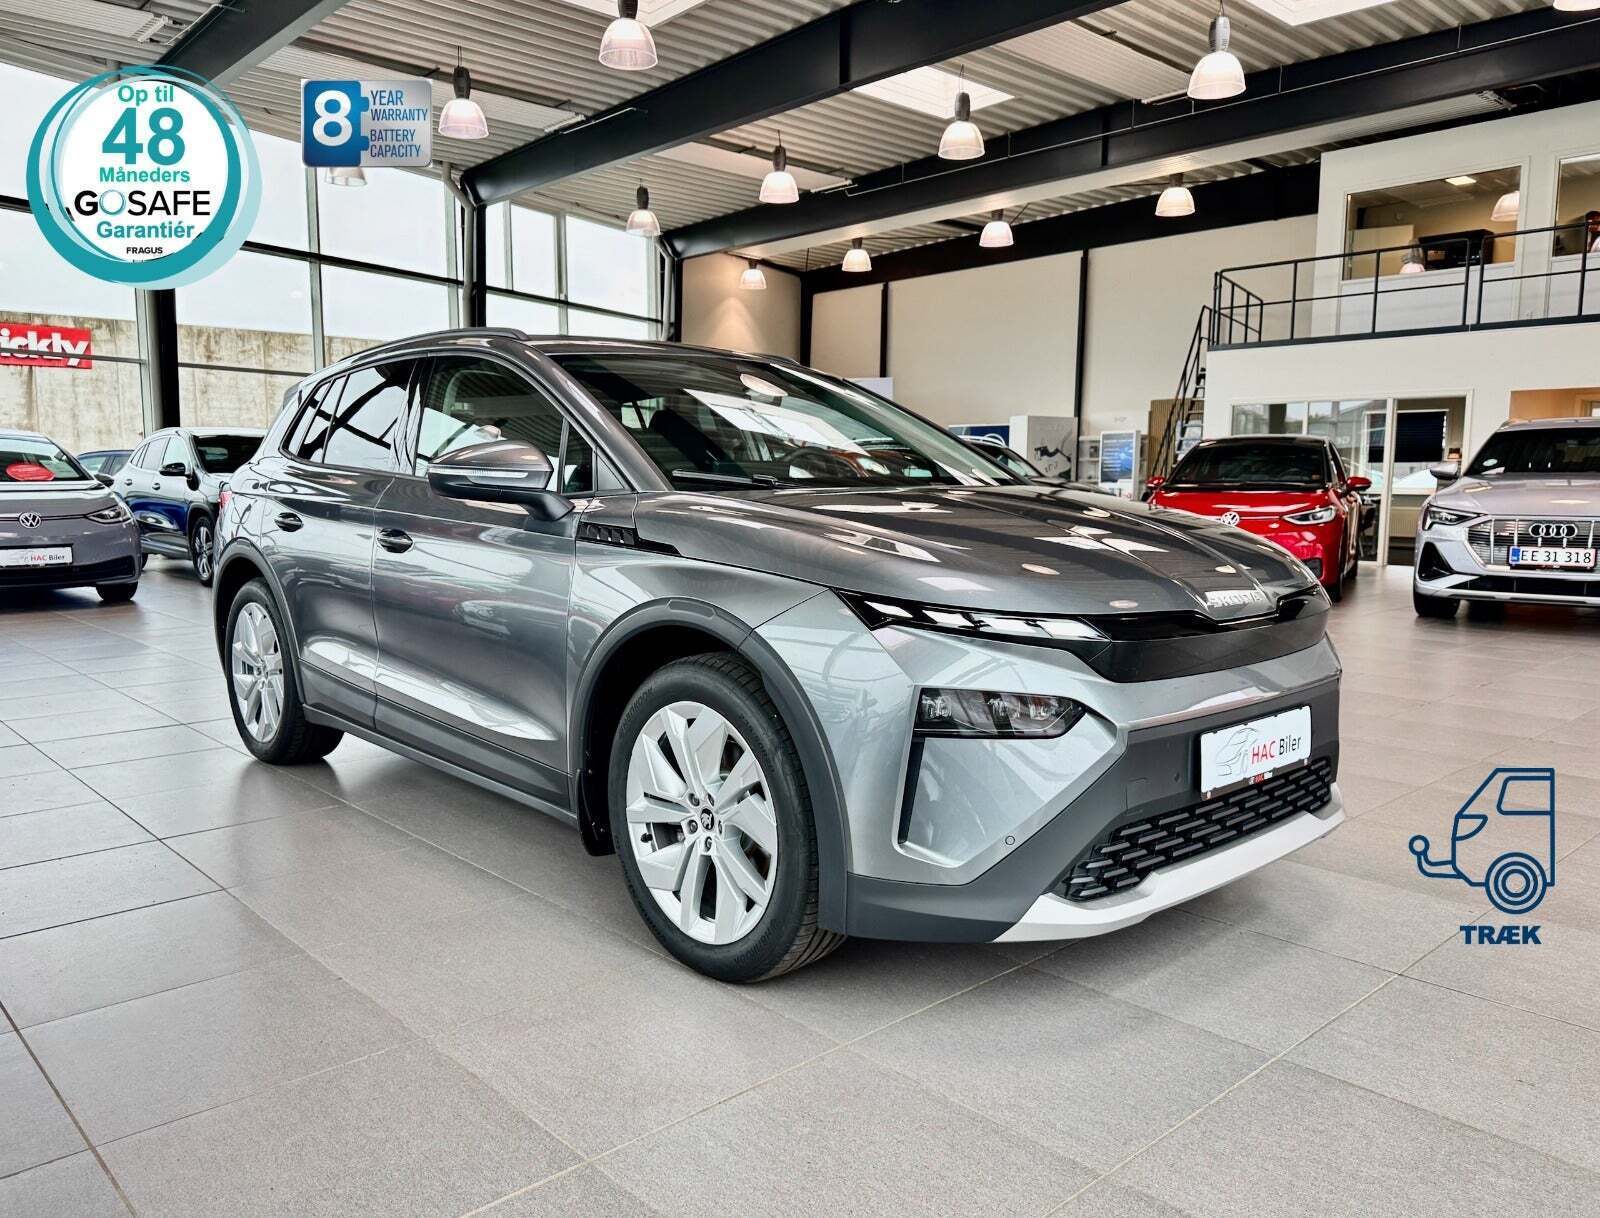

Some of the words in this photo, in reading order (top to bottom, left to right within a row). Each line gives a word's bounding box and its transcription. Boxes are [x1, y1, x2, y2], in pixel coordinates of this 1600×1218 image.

[1521, 550, 1540, 562] EE
[1543, 550, 1559, 563] 31
[1564, 551, 1592, 564] 318
[1251, 740, 1276, 765] HAC
[1279, 734, 1301, 756] Biler
